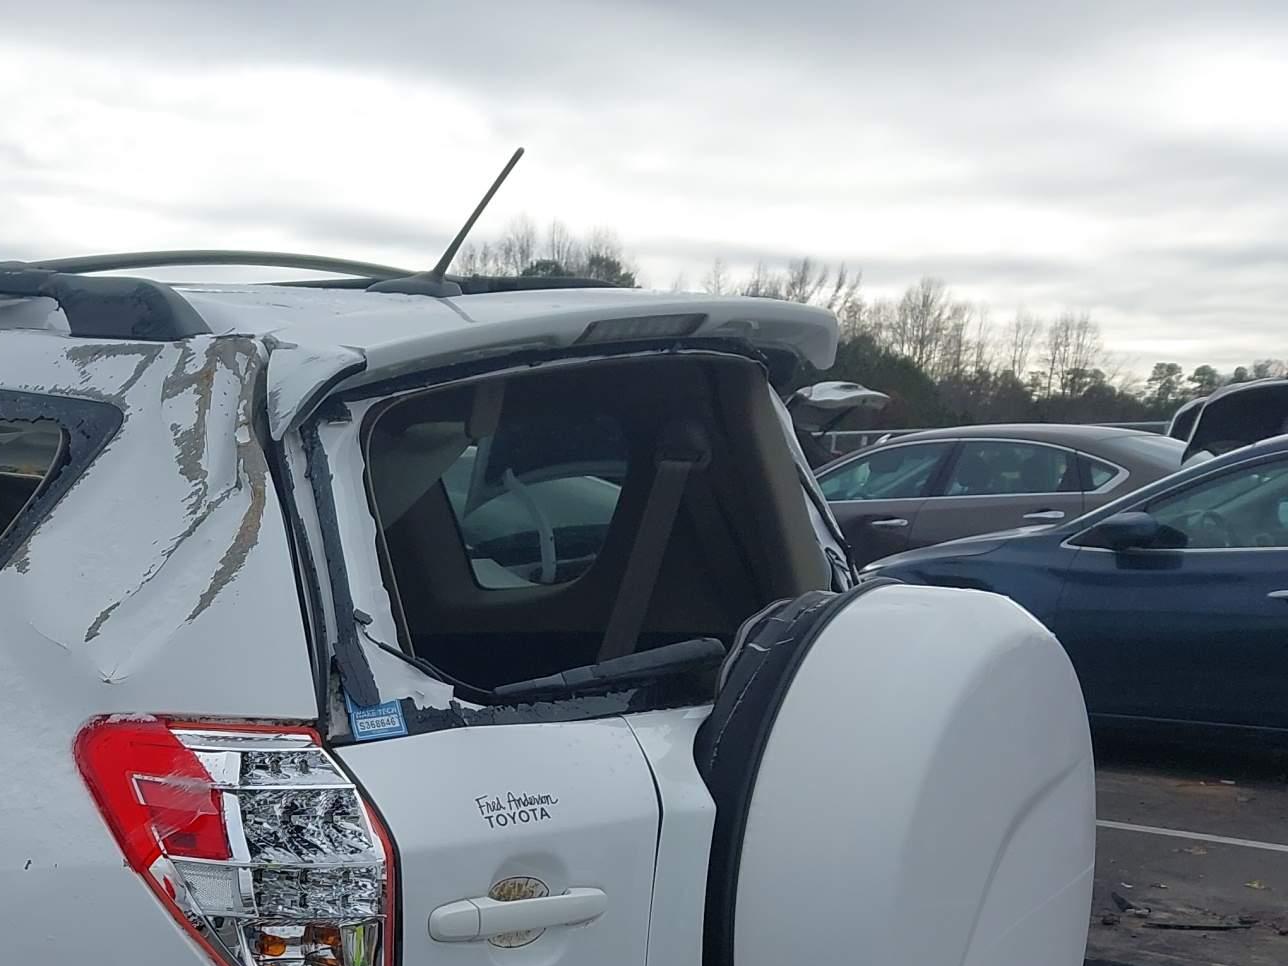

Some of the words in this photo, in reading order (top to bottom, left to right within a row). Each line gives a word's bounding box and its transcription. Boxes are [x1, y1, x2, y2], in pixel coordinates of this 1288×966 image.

[475, 794, 506, 816] Fred
[507, 792, 559, 811] Anderson
[484, 807, 552, 829] TOYOTA
